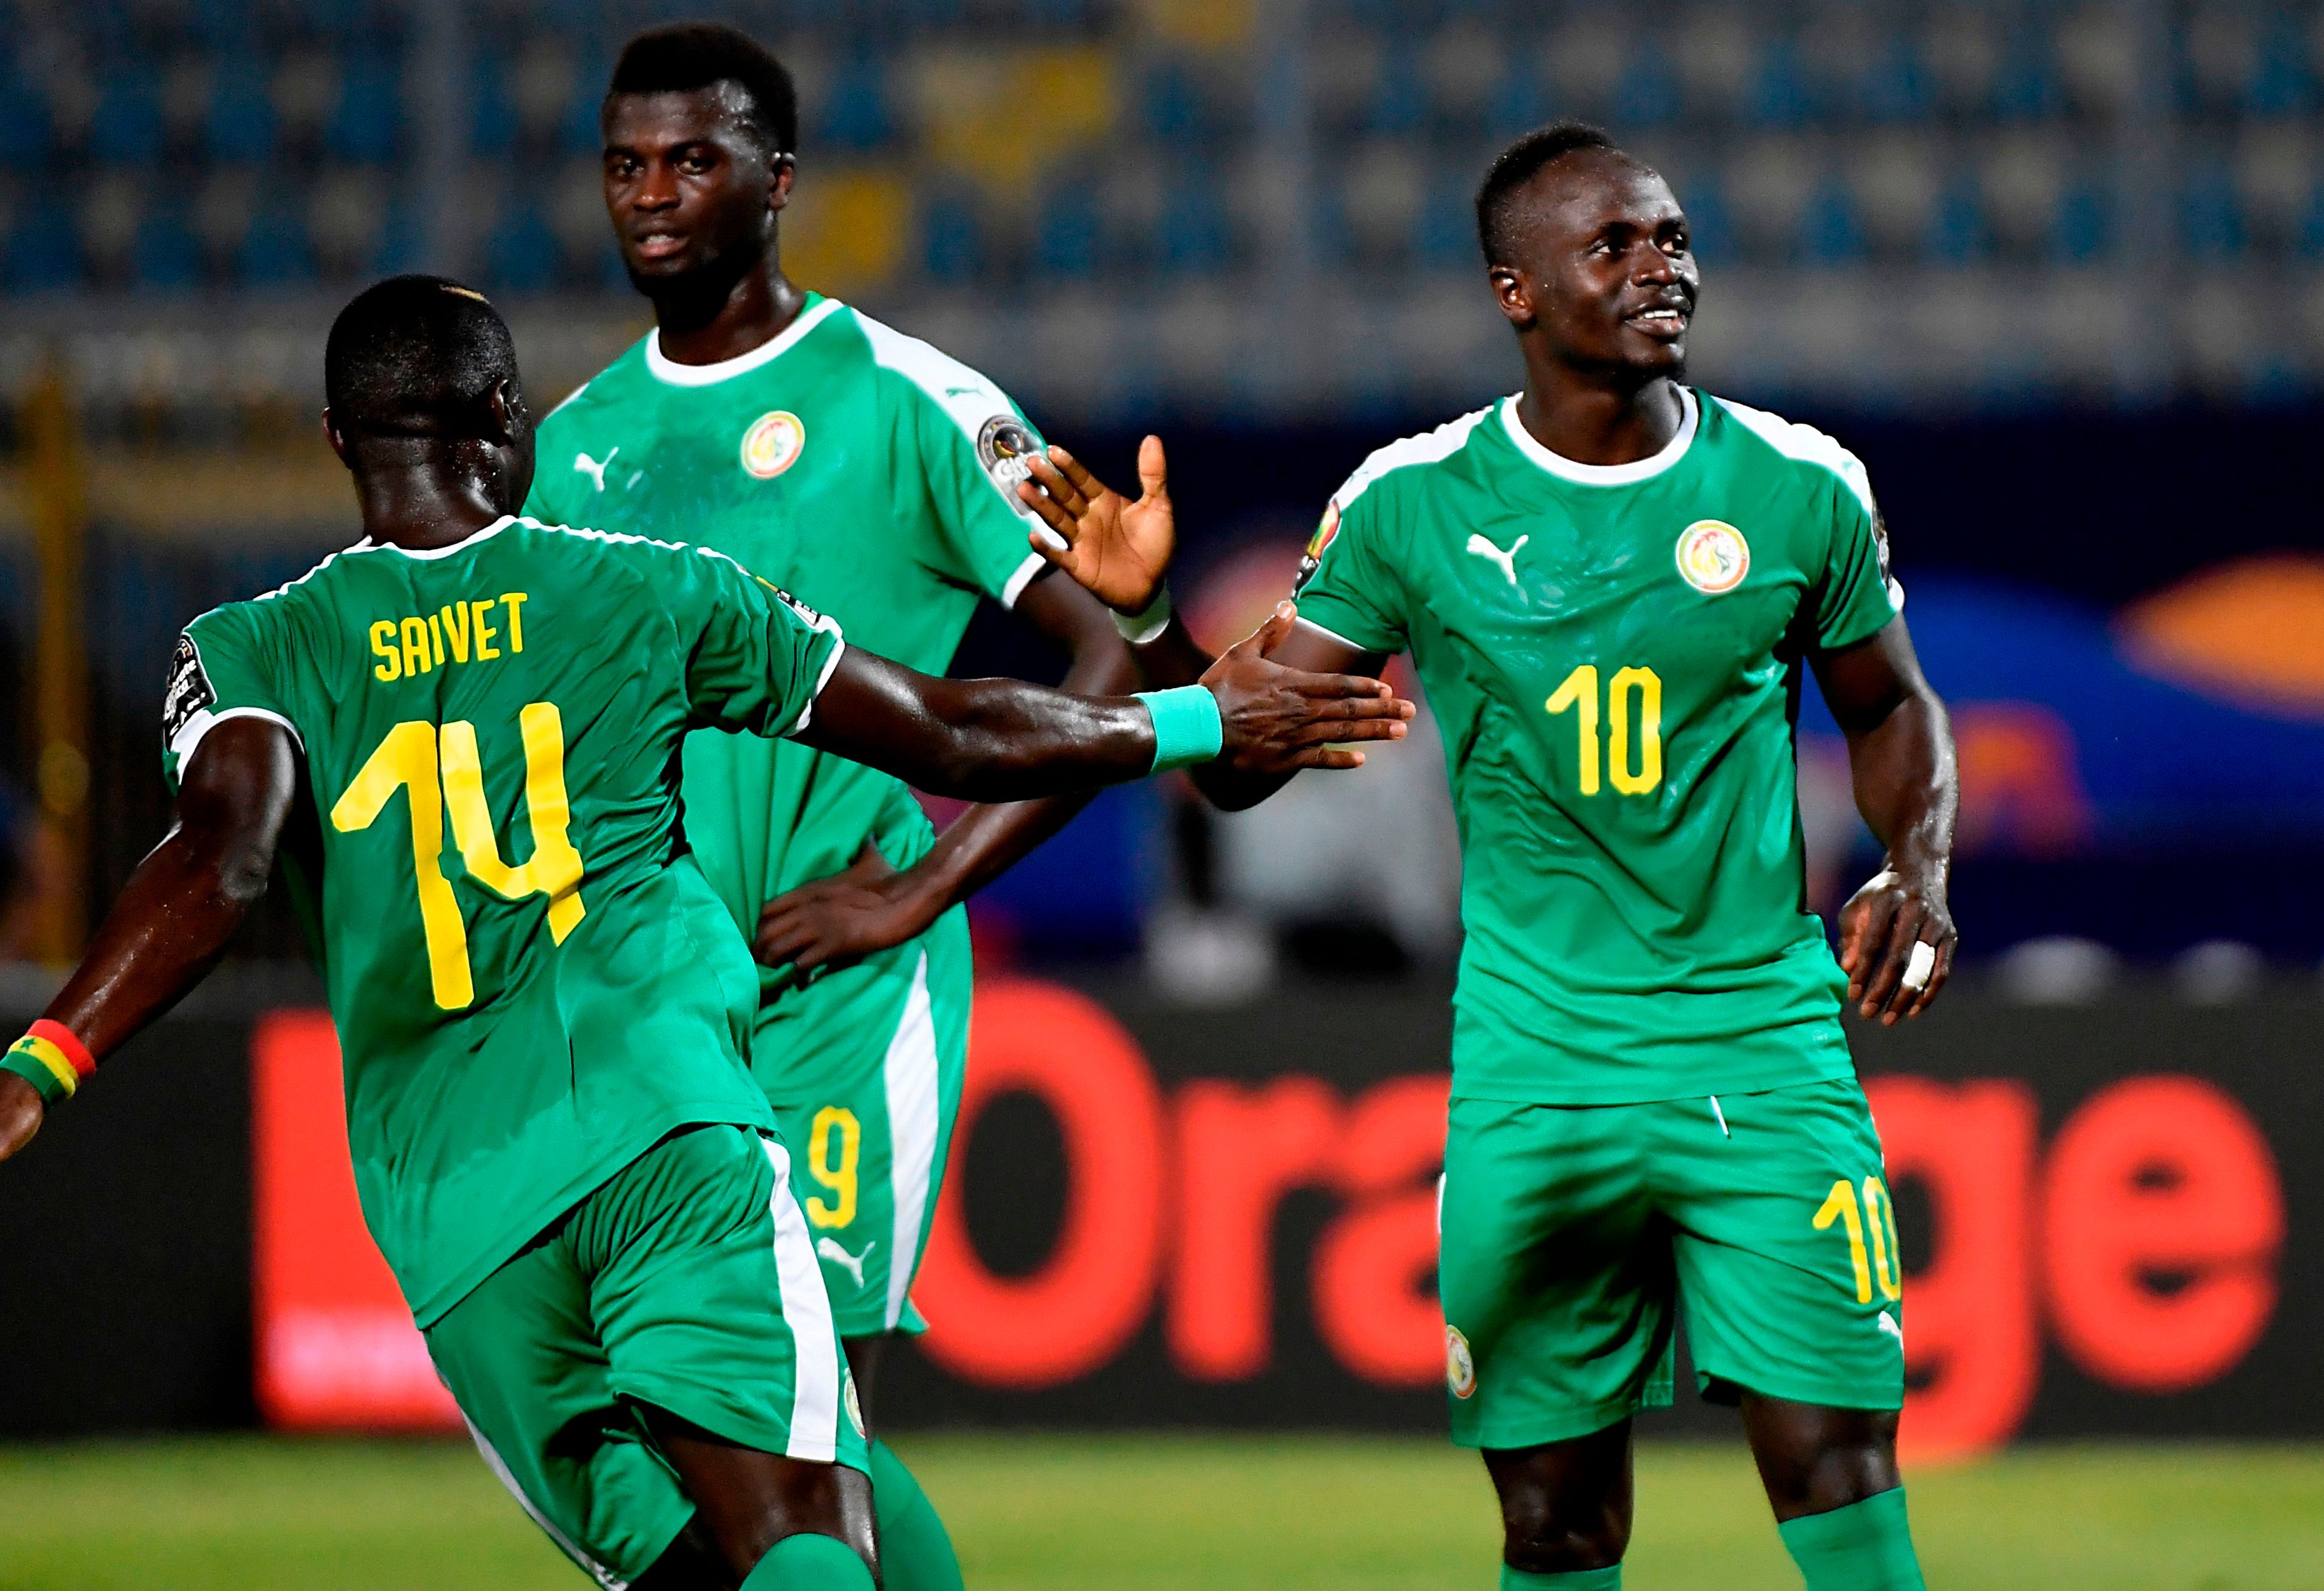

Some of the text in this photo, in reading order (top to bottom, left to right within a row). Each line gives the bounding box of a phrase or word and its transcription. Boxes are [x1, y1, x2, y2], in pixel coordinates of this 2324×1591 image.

[369, 593, 527, 681] SAIVET
[1545, 665, 1662, 796] 10
[331, 702, 586, 1010] 14
[806, 1106, 860, 1229] 9
[910, 978, 2283, 1469] Orage
[1813, 1175, 1903, 1304] 10
